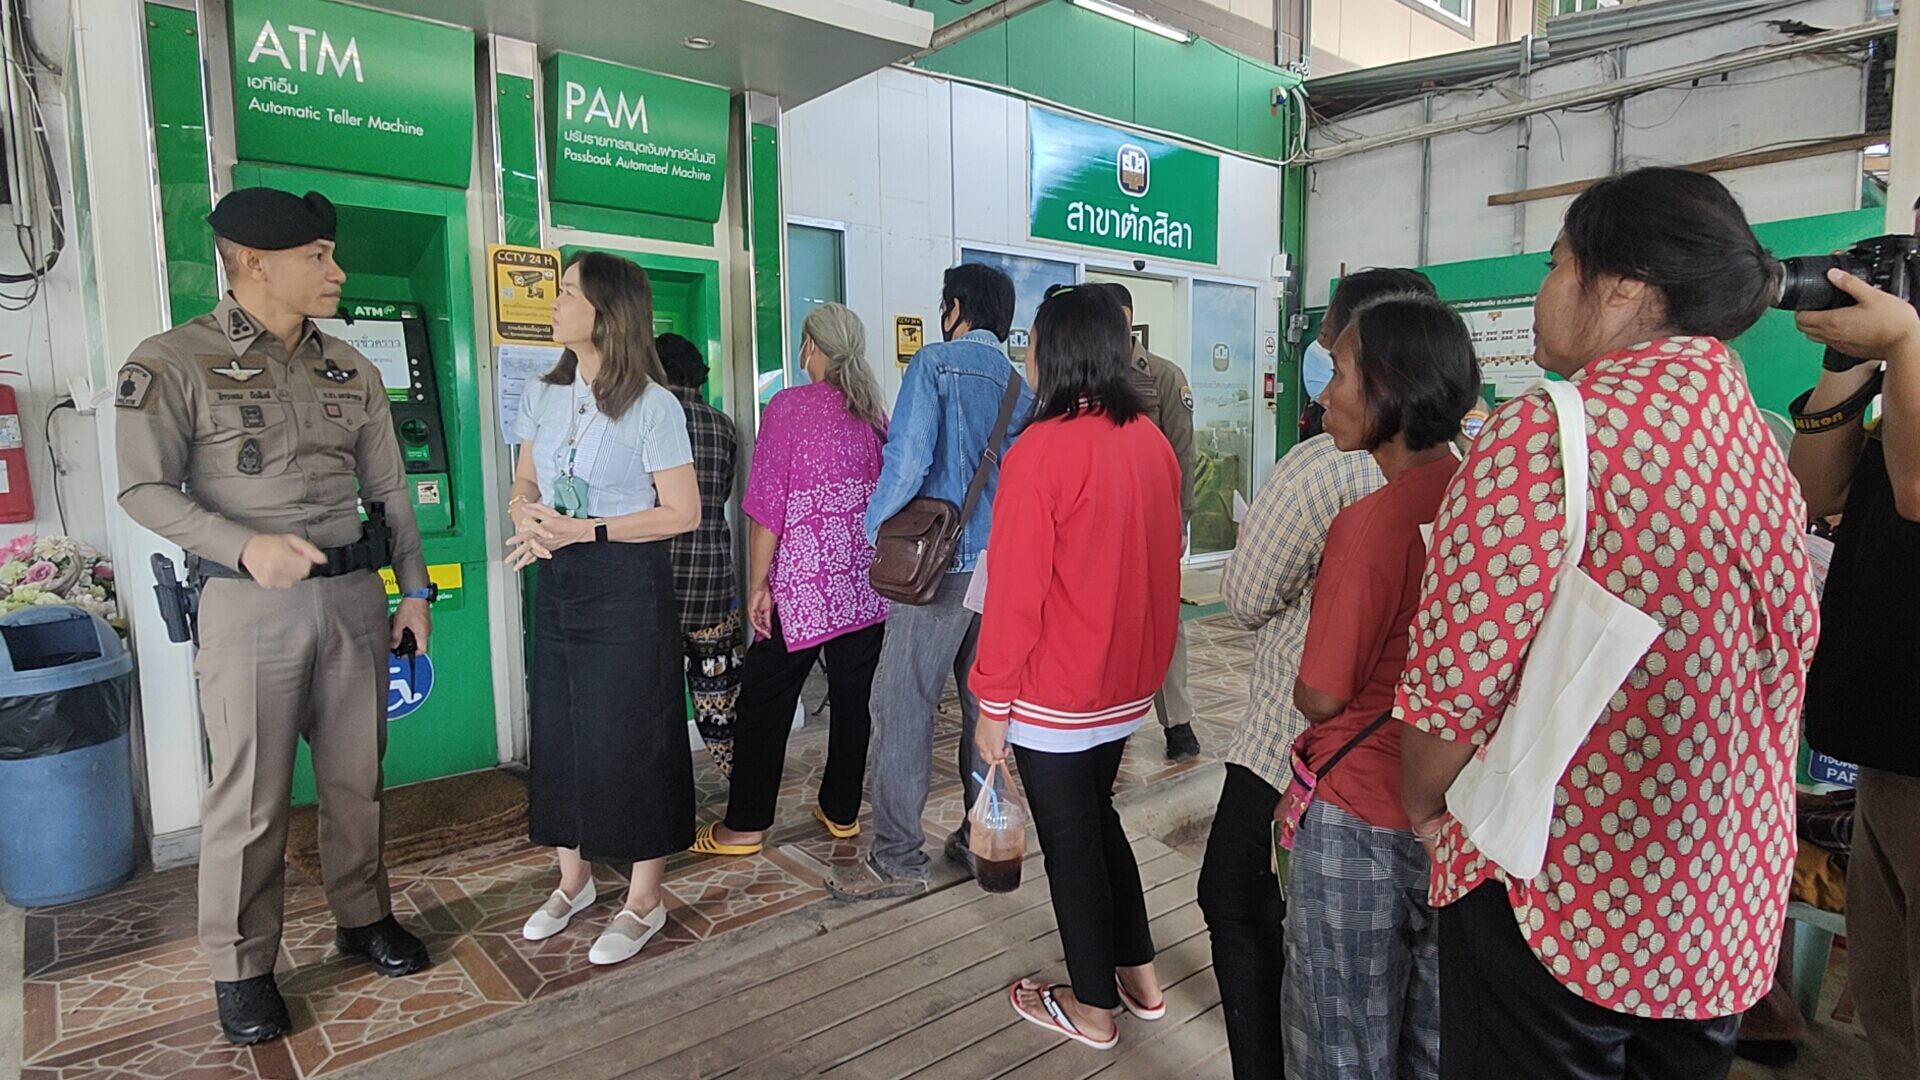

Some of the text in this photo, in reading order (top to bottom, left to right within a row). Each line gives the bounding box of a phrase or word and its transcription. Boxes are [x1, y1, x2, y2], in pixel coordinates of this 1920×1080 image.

[247, 19, 364, 83] ATM
[247, 76, 299, 95] เอทีเอ็ม
[248, 97, 424, 136] Automatic Teller Machine
[566, 81, 649, 134] PAM
[564, 147, 711, 182] Passbook Automated Machine
[1067, 201, 1193, 250] สาขาตักสิลา
[497, 251, 553, 266] CCTV 24 H
[355, 306, 384, 317] ATM
[1796, 412, 1843, 429] Nikon
